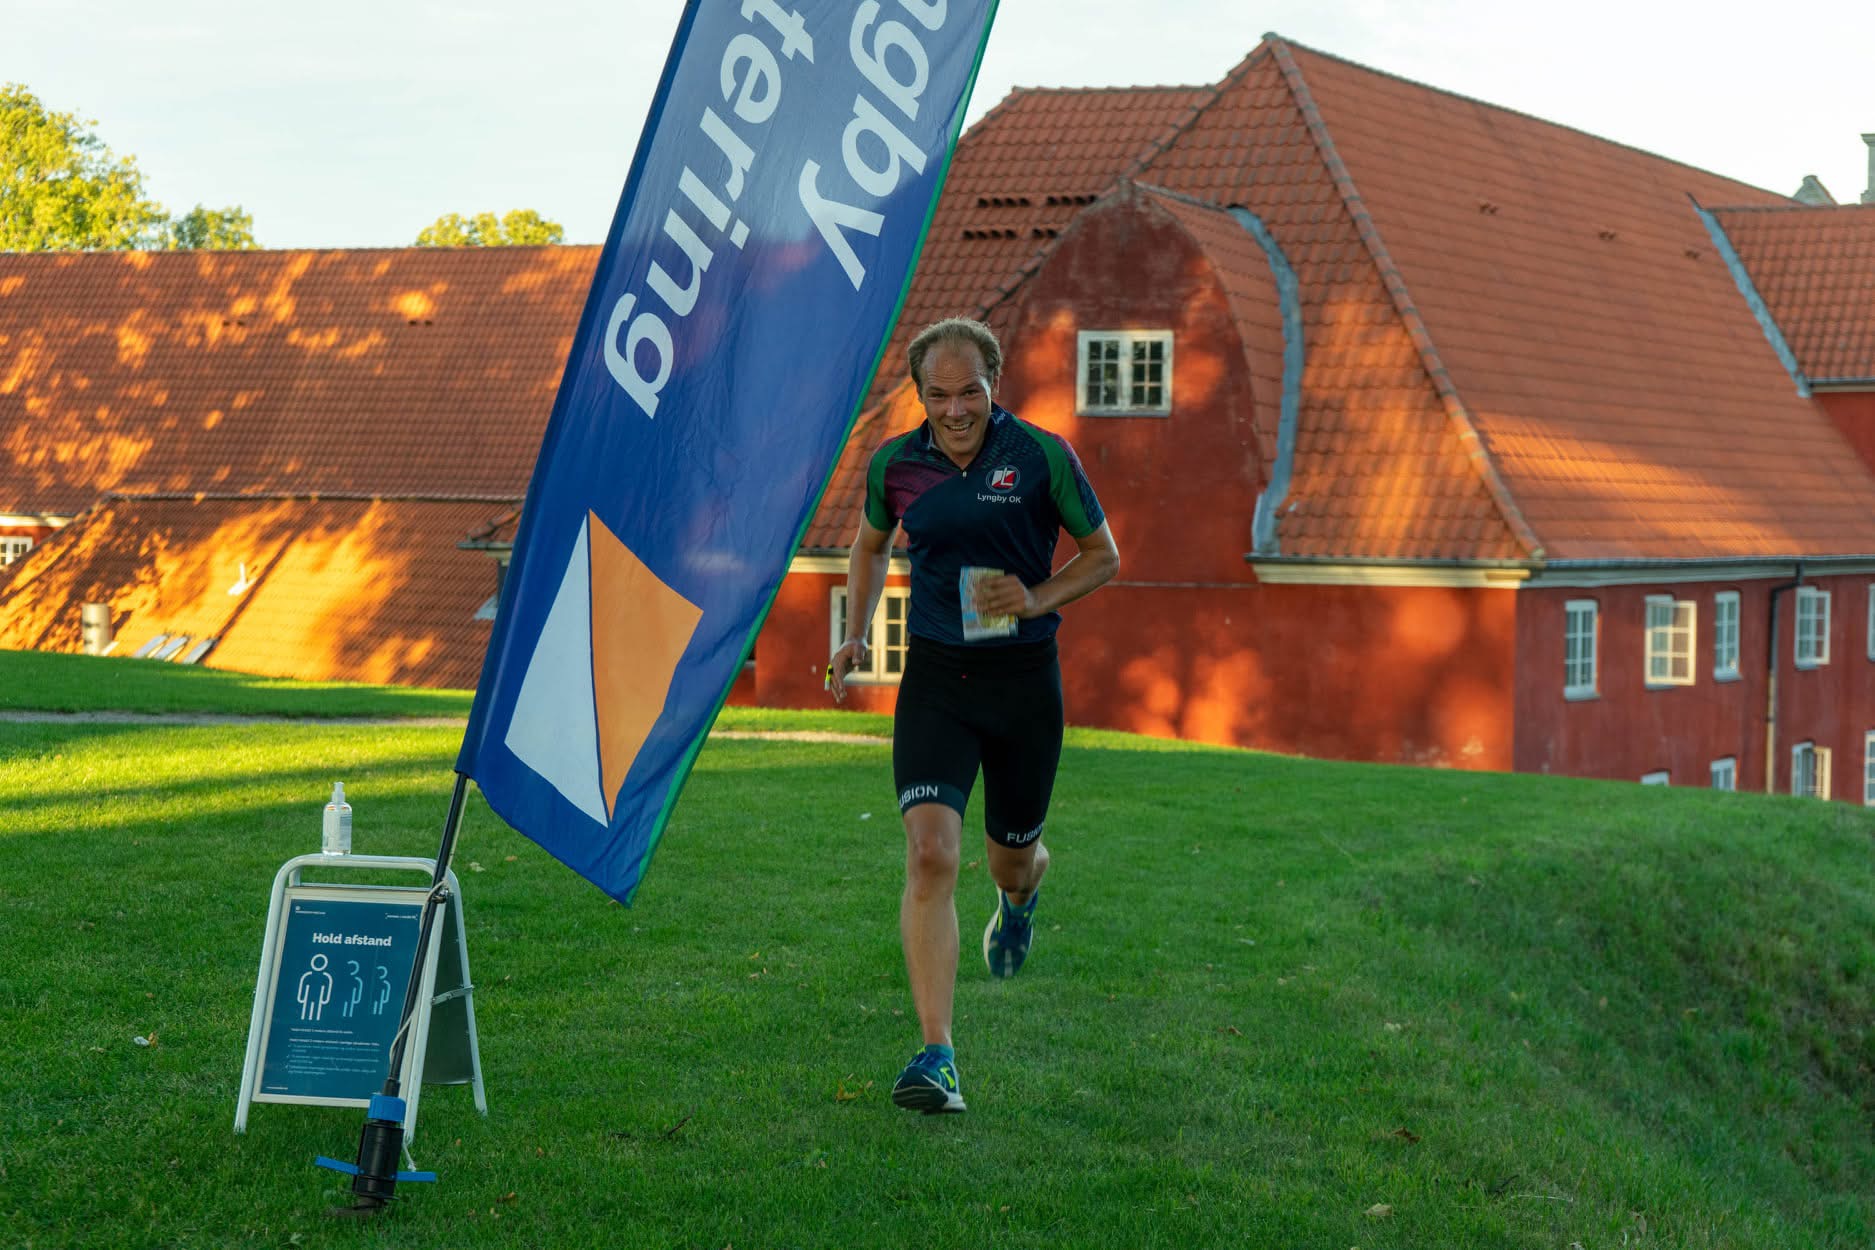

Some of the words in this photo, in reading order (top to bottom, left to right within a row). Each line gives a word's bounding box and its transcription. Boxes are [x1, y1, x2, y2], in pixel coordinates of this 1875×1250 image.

[603, 0, 814, 420] tering
[977, 493, 1007, 503] Lyngby
[1009, 495, 1021, 503] OK
[312, 932, 342, 944] Hold
[344, 935, 392, 946] afstand
